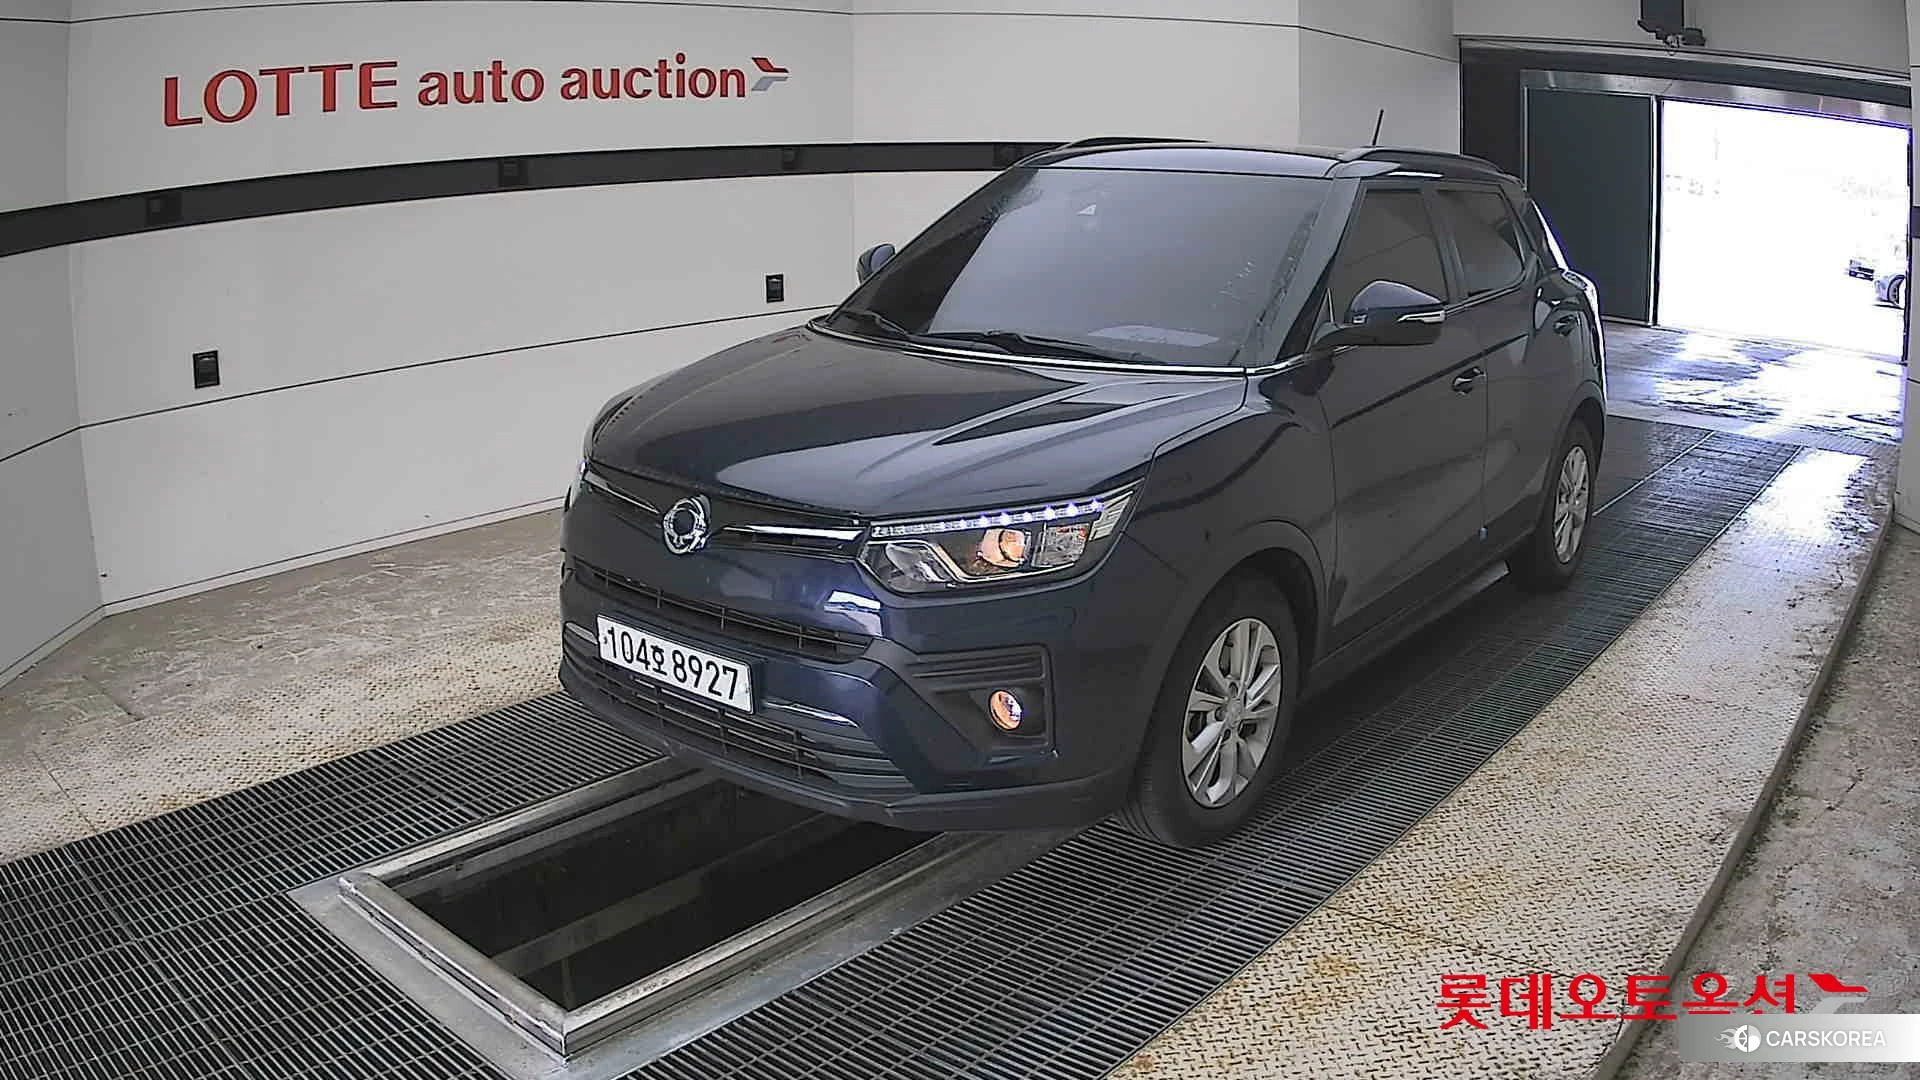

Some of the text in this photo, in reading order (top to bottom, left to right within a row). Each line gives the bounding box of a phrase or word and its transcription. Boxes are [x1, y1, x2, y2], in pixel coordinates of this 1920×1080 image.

[164, 53, 746, 127] LOTTE auto auction
